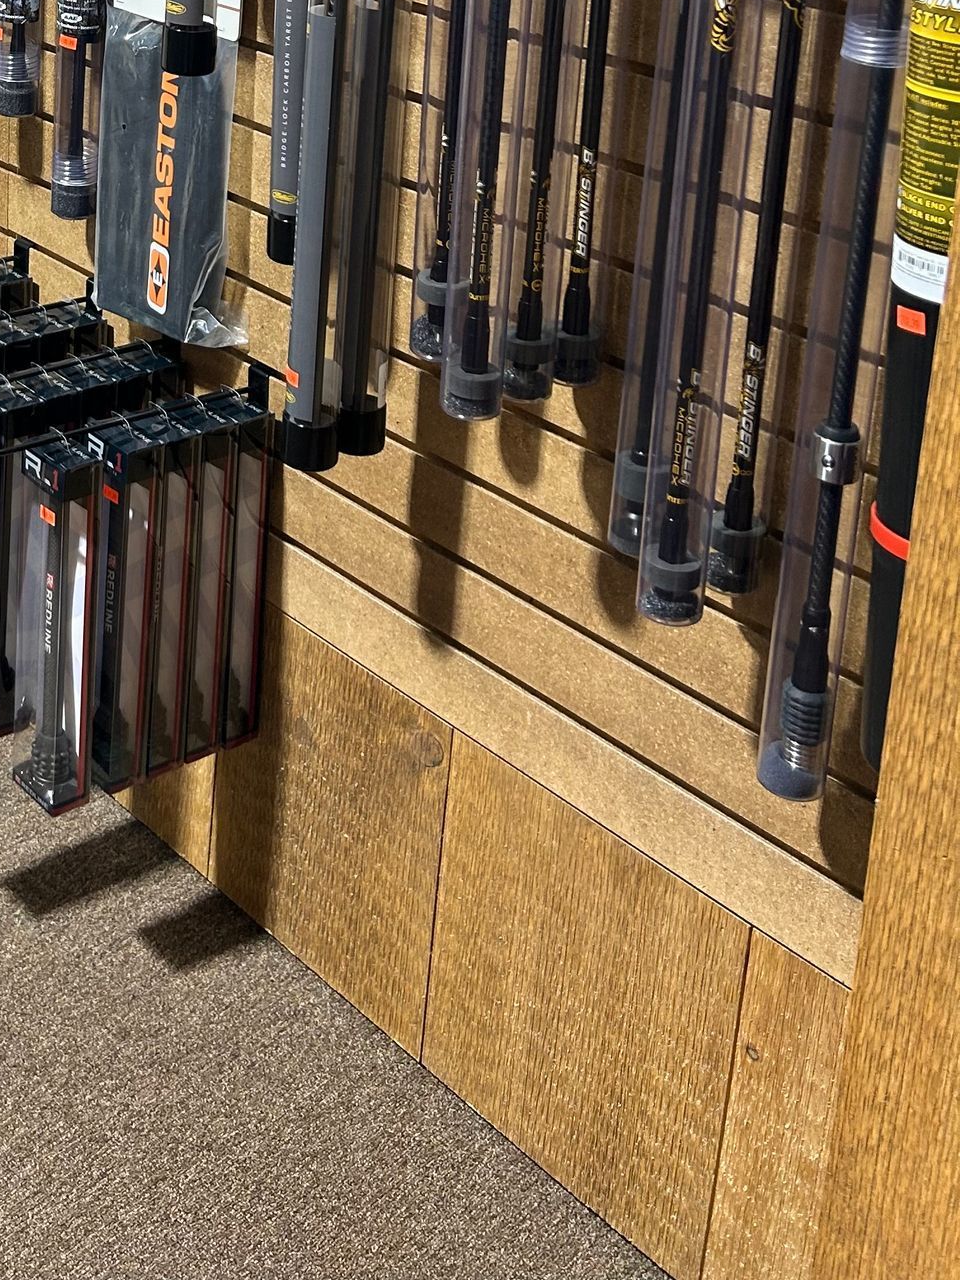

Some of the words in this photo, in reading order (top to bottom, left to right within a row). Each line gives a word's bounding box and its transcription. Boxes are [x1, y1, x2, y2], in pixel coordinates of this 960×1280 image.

[284, 8, 293, 47] TARGET
[282, 52, 291, 94] CARBON
[152, 71, 180, 248] EASTON
[533, 197, 544, 273] MICROHEX
[575, 176, 593, 258] STINGER
[924, 212, 946, 225] END
[925, 199, 947, 212] END
[478, 207, 489, 284] MICROHEX
[671, 406, 686, 487] MICROHEX
[737, 373, 760, 460] STINGER
[44, 588, 55, 655] REDLINE
[103, 570, 116, 635] REDLINE
